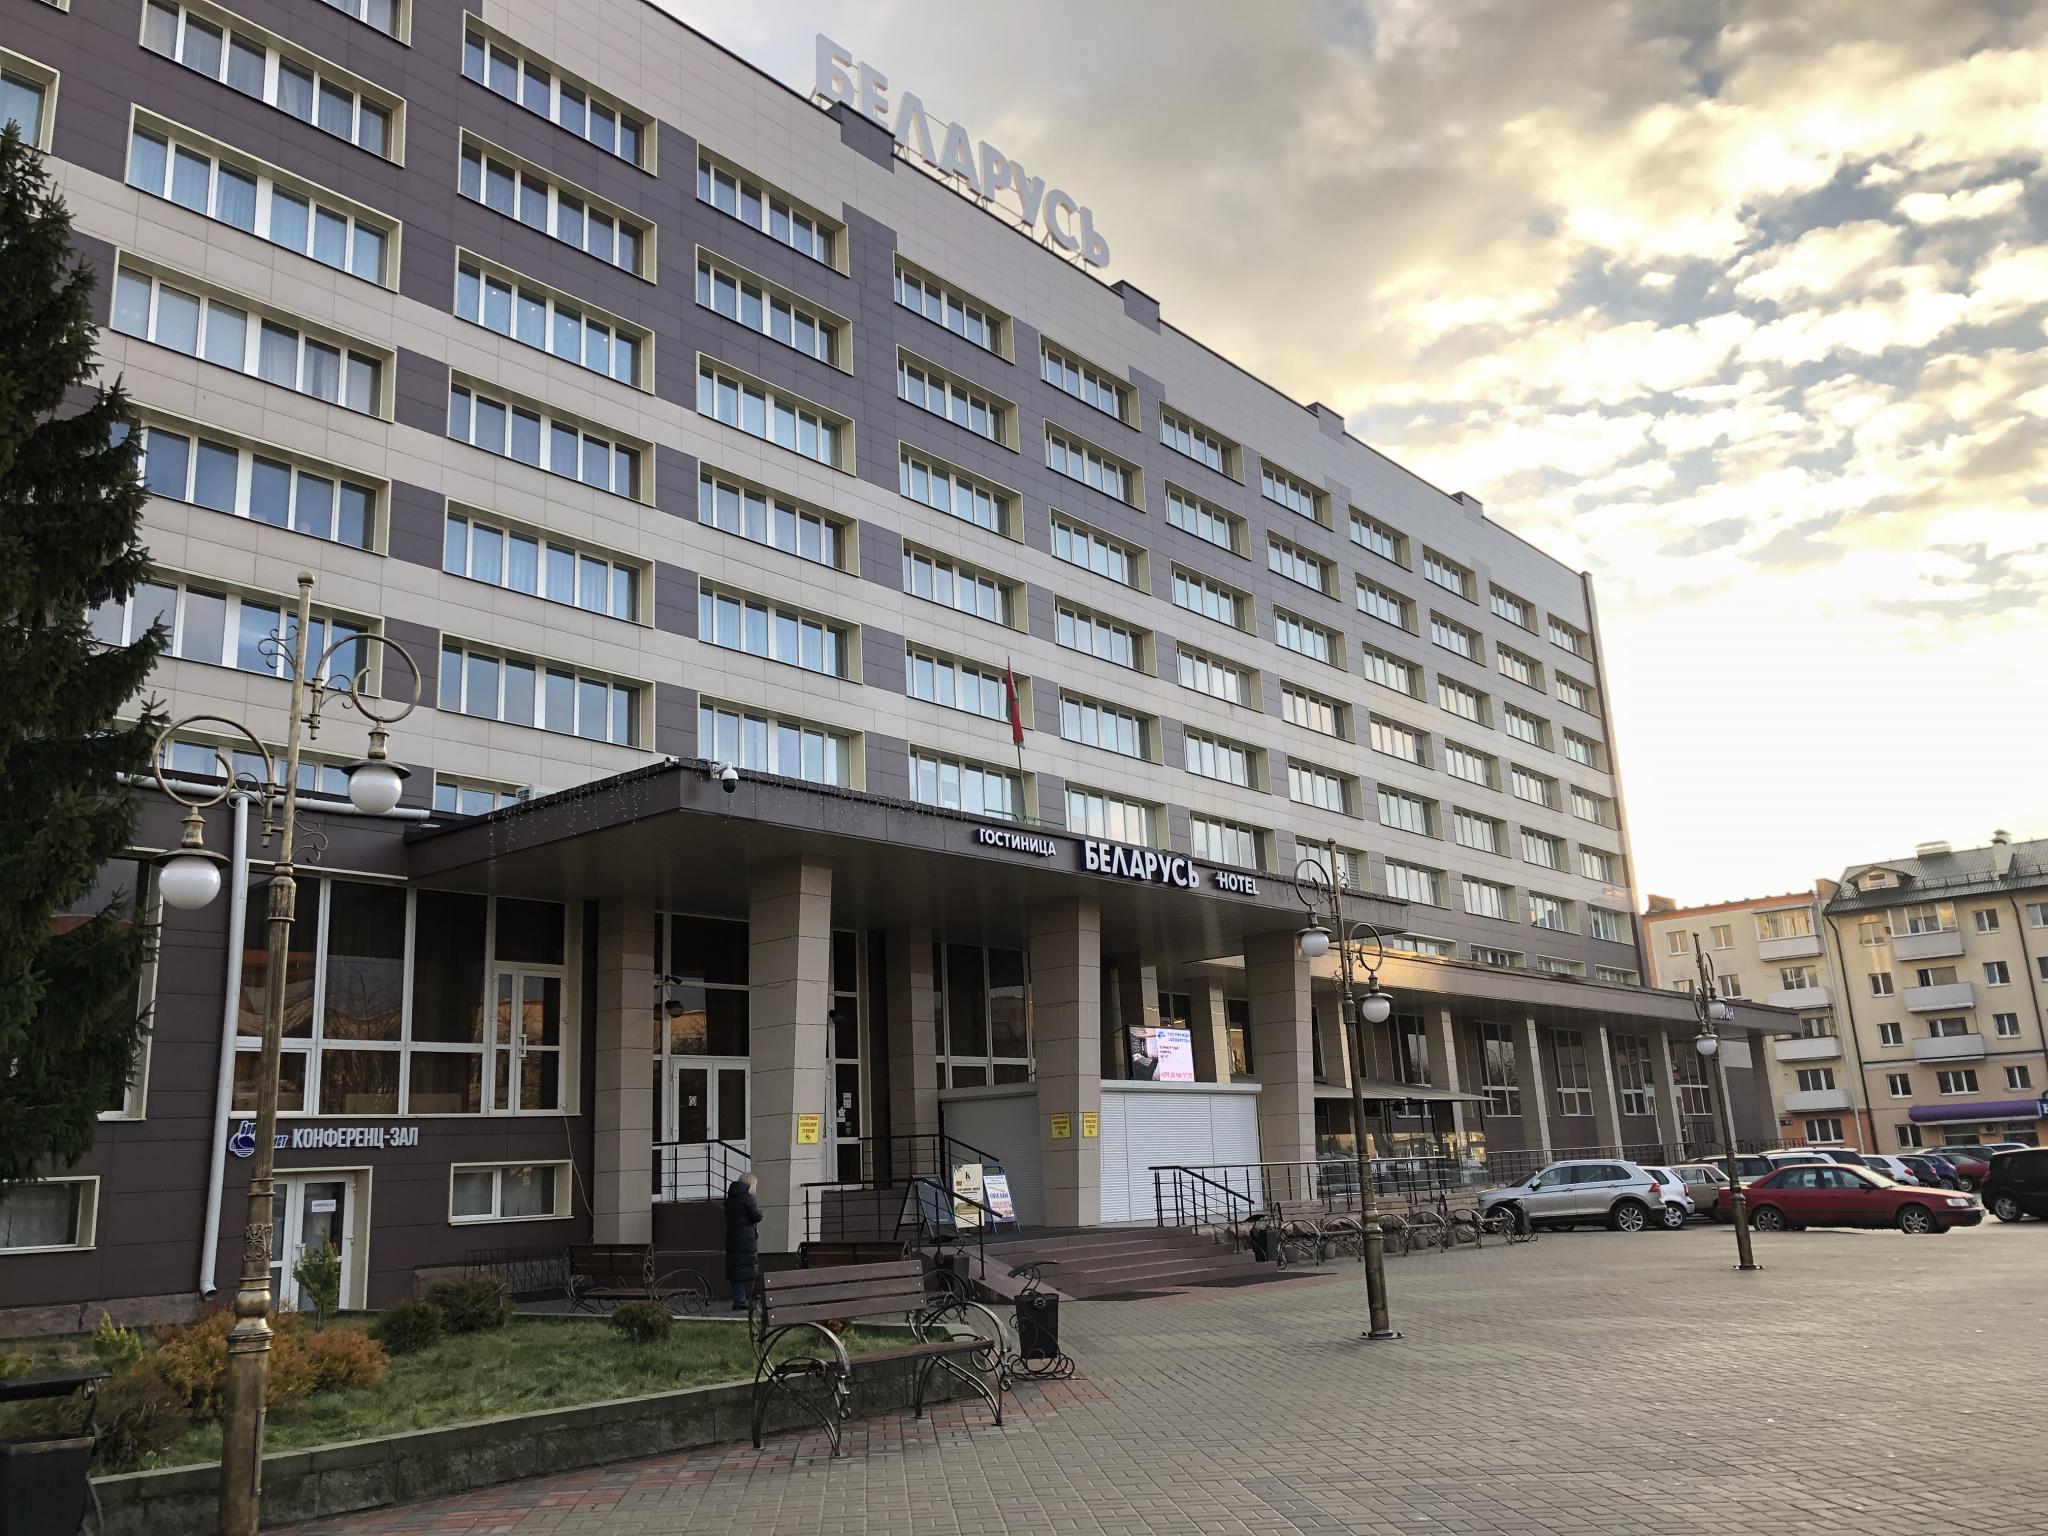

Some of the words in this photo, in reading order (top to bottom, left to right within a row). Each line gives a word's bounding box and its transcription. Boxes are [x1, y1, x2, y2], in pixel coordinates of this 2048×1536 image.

[815, 33, 1110, 269] БЕЛАРУСЬ
[978, 828, 1057, 857] ГОСТИНИЦА
[1084, 839, 1200, 889] БЕЛАРУСЬ
[1217, 871, 1261, 896] HOTEL
[292, 1127, 419, 1149] КОНФЕРЕНЦ-ЗАЛ
